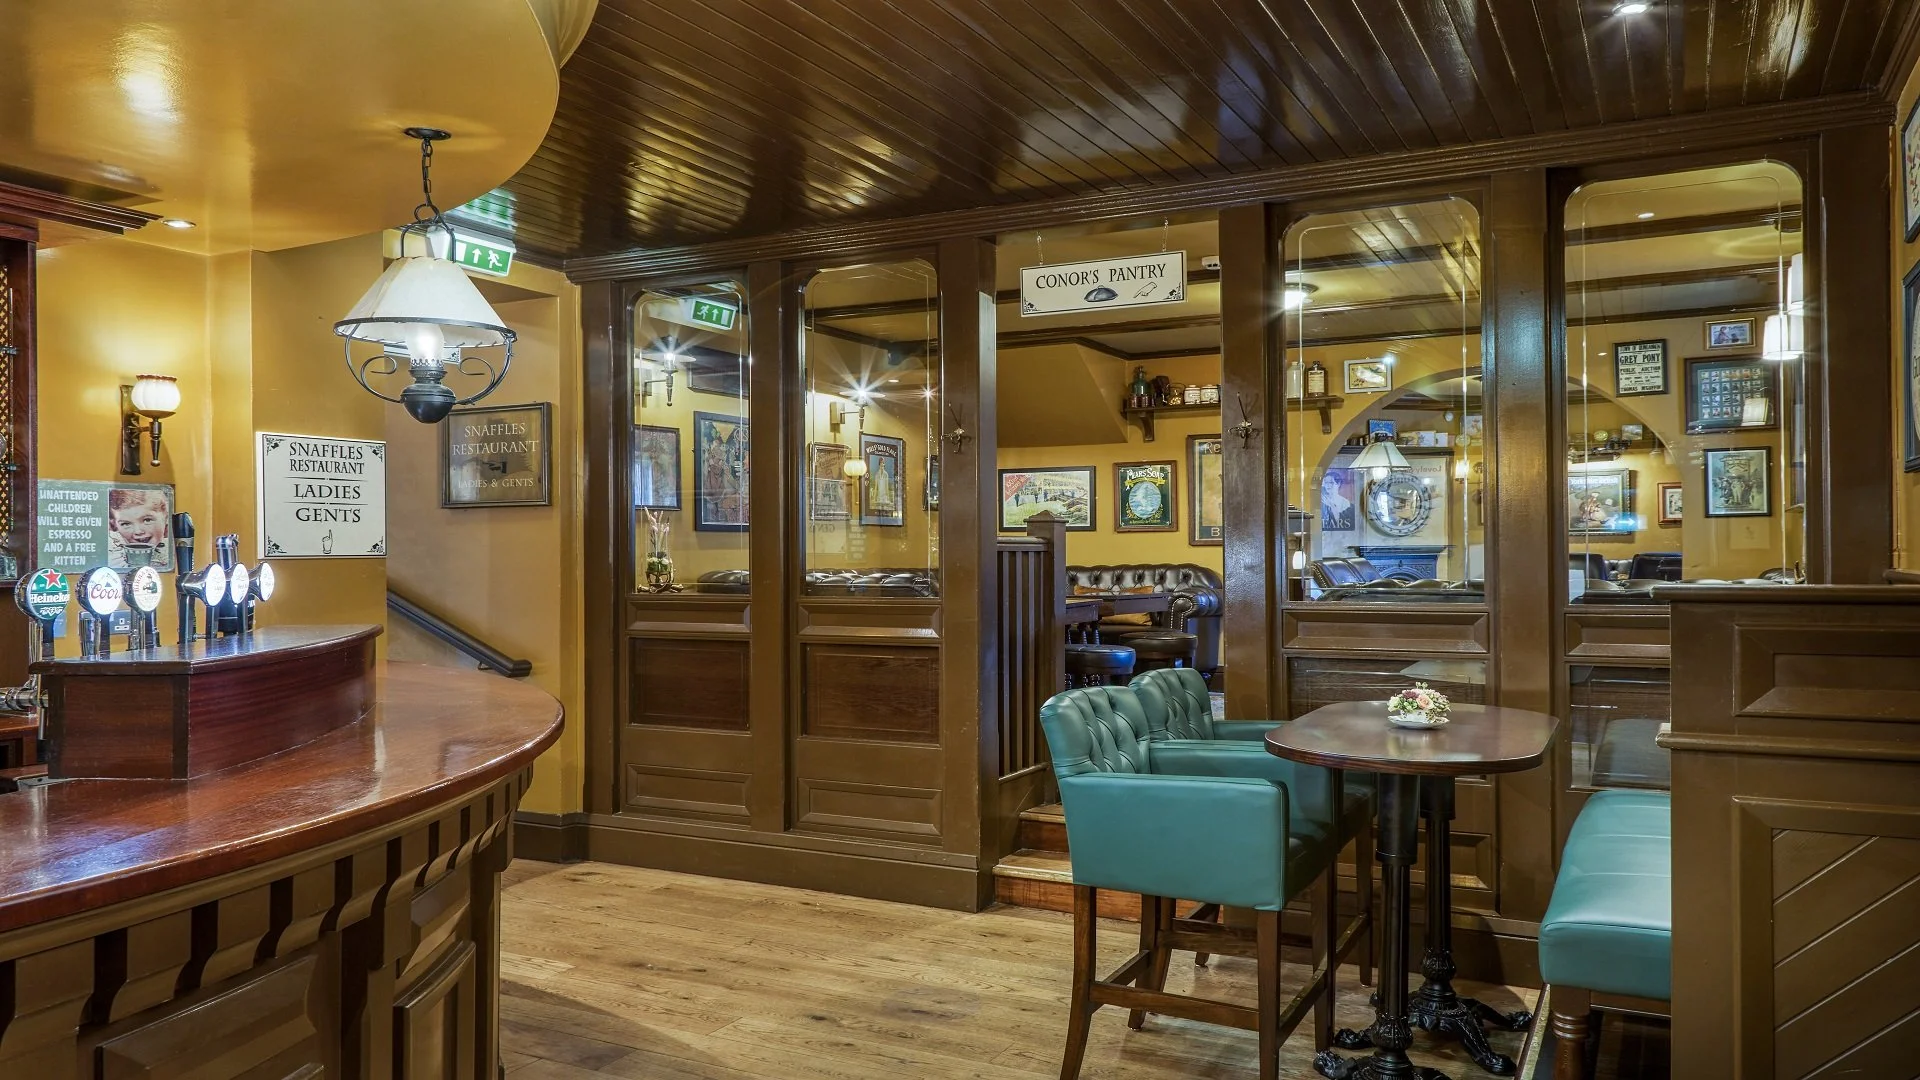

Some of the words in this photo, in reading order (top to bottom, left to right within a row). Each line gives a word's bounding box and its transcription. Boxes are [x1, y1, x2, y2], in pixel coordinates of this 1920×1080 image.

[1035, 269, 1099, 289] CONOR'S
[1108, 263, 1167, 283] PANTRY
[1619, 354, 1638, 364] GREY
[1642, 353, 1661, 362] PONY
[464, 422, 525, 438] SNAFFLES
[289, 441, 363, 461] SNAFFLES
[451, 440, 539, 456] RESTAURANT
[289, 458, 365, 475] RESTAURANT
[490, 479, 498, 489] &
[502, 478, 534, 488] GENTS
[38, 490, 99, 501] UNATTENDED
[293, 483, 361, 500] LADIES
[48, 503, 92, 514] CHILDREN
[37, 515, 60, 526] WILL
[61, 516, 73, 526] BE
[75, 516, 102, 527] GIVEN
[295, 507, 361, 523] GENTS
[48, 529, 92, 540] ESPRESSO
[43, 542, 63, 553] AND
[65, 542, 73, 553] A
[74, 543, 96, 553] FREE
[54, 556, 86, 566] KITTEN
